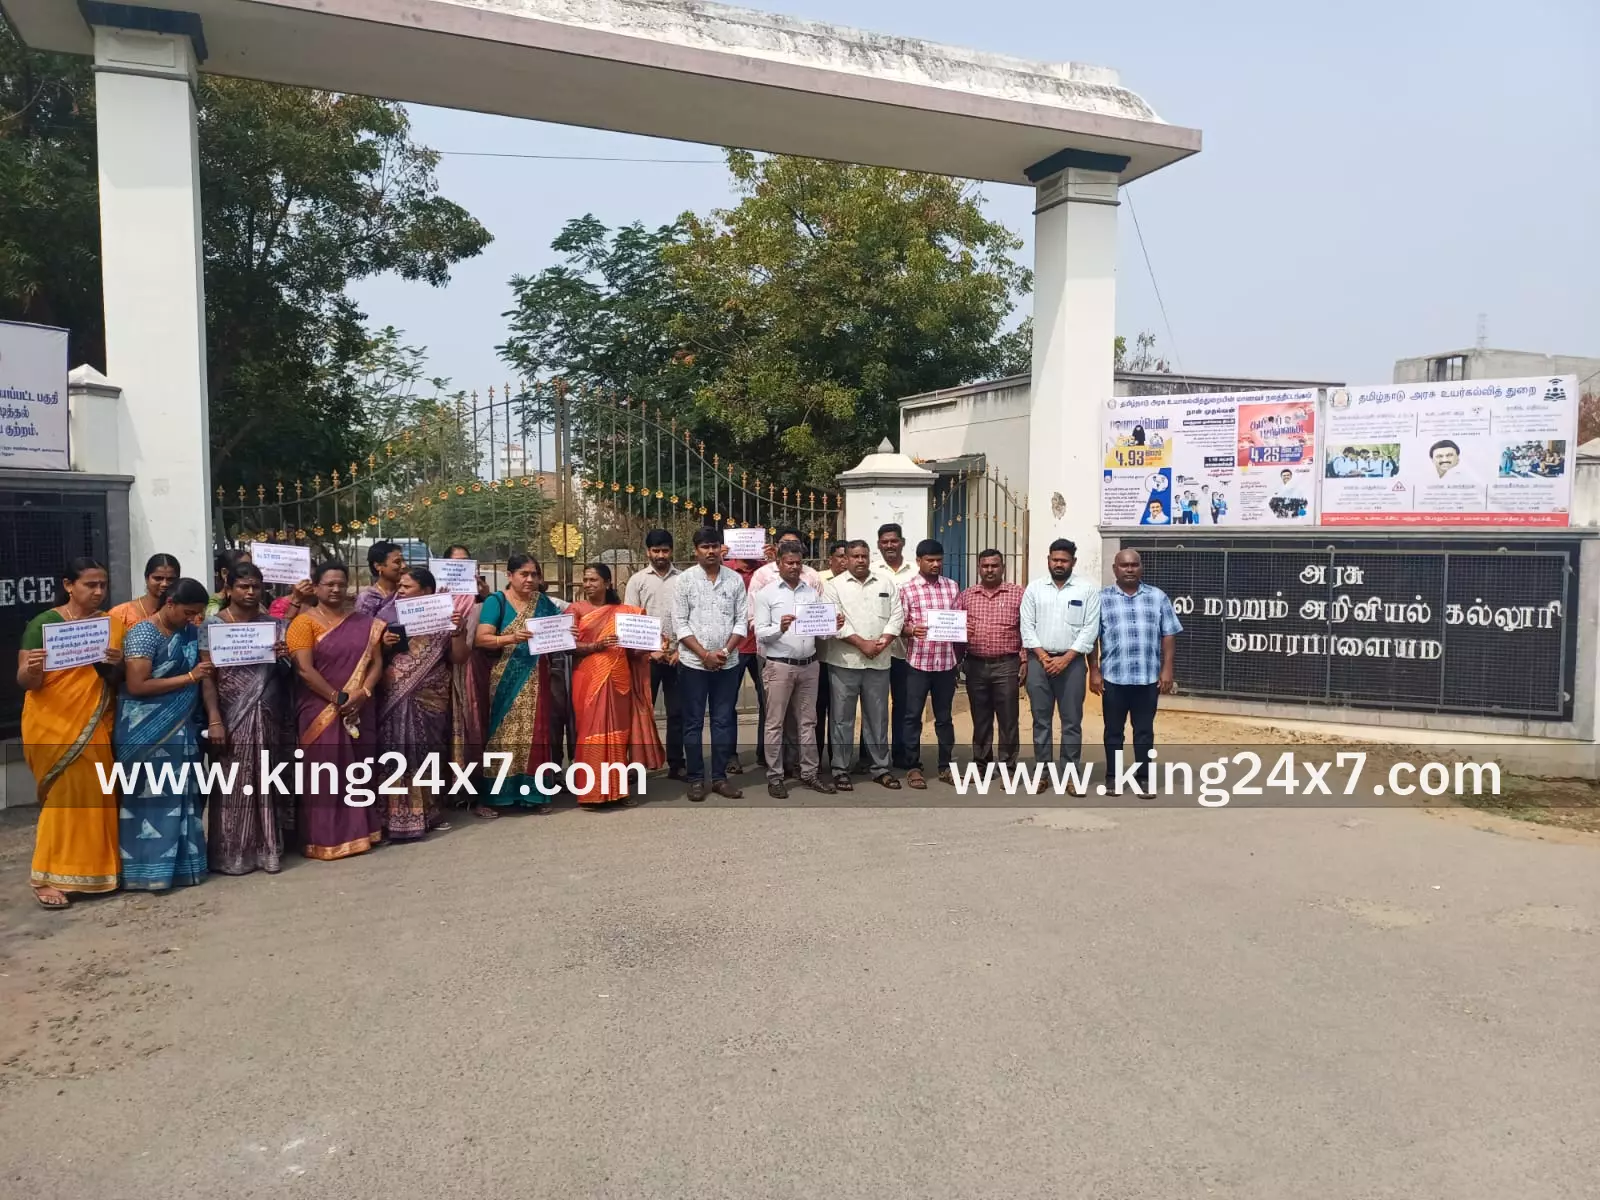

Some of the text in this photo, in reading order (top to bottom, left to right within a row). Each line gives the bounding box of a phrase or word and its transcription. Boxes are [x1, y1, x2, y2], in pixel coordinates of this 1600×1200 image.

[1358, 389, 1406, 405] தமிழ்நாடு
[1410, 390, 1437, 401] அரசு
[1505, 386, 1537, 399] துறை
[1115, 449, 1144, 466] 4.93
[1250, 446, 1280, 463] 4.25
[1300, 565, 1365, 588] அரசு
[1300, 594, 1432, 625] அறிவியல்
[1445, 597, 1562, 631] கல்லூரி
